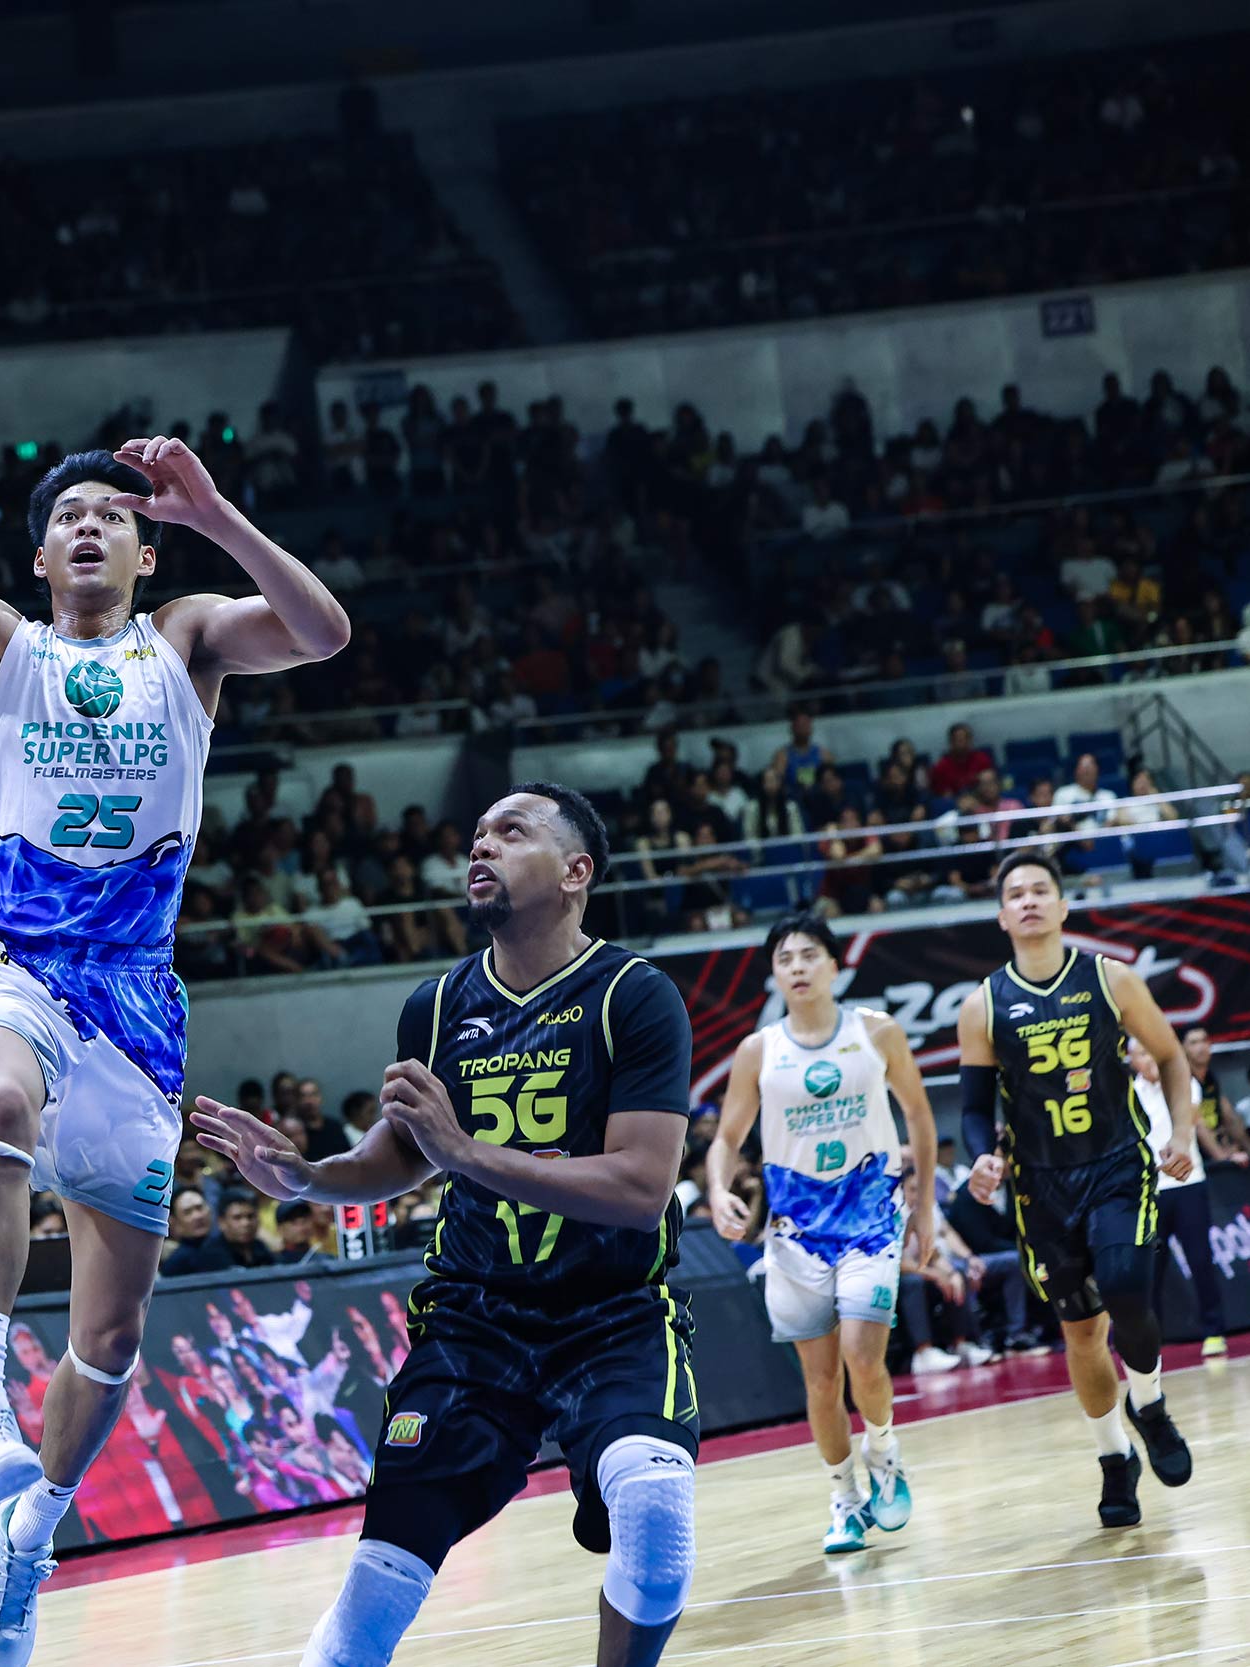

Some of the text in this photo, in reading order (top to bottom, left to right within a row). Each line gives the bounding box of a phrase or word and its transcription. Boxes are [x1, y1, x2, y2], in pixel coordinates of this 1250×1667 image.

[21, 721, 168, 741] PHOENIX
[23, 741, 168, 767] SUPER LPG
[50, 793, 143, 849] 25
[457, 1028, 479, 1041] ANTA
[1015, 1013, 1091, 1038] TROPANG
[458, 1048, 571, 1077] TROPANG
[1027, 1026, 1091, 1075] 5G
[460, 1070, 567, 1146] 5G
[784, 1092, 866, 1118] PHOENIX
[787, 1111, 835, 1132] SUPER
[839, 1105, 867, 1122] LPG
[1044, 1094, 1093, 1137] 16
[815, 1140, 847, 1172] 19
[133, 1158, 173, 1208] 2
[496, 1200, 564, 1265] 17
[388, 1418, 423, 1441] TNT
